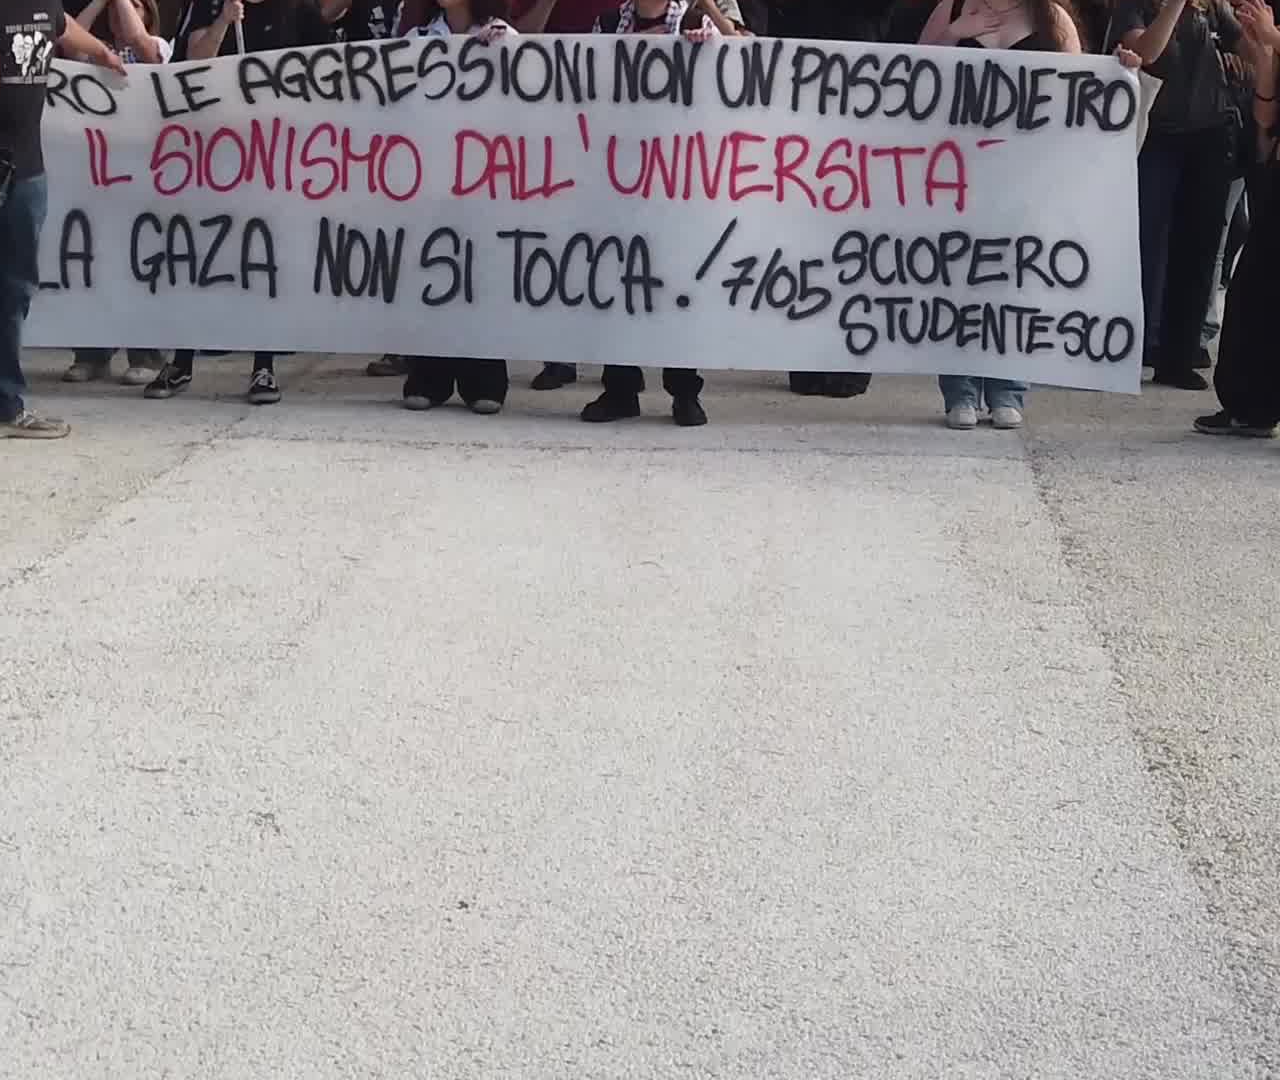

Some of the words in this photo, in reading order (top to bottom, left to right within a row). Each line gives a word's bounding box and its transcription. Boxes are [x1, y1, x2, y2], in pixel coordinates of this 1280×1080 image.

[47, 68, 117, 115] RO
[151, 66, 220, 119] LE
[238, 38, 596, 105] AGGRESSIONI
[613, 40, 700, 106] NON
[719, 40, 783, 109] UN
[792, 45, 942, 122] PASSO
[949, 61, 1136, 131] INDIETRO
[84, 127, 132, 188] IL
[38, 208, 95, 290] A
[129, 211, 278, 299] GAZA
[314, 218, 404, 305] NON
[422, 226, 473, 307] SI
[721, 247, 832, 321] 7/05
[831, 229, 1089, 288] SCIOPERO
[838, 293, 1134, 363] STUDENTESCO
